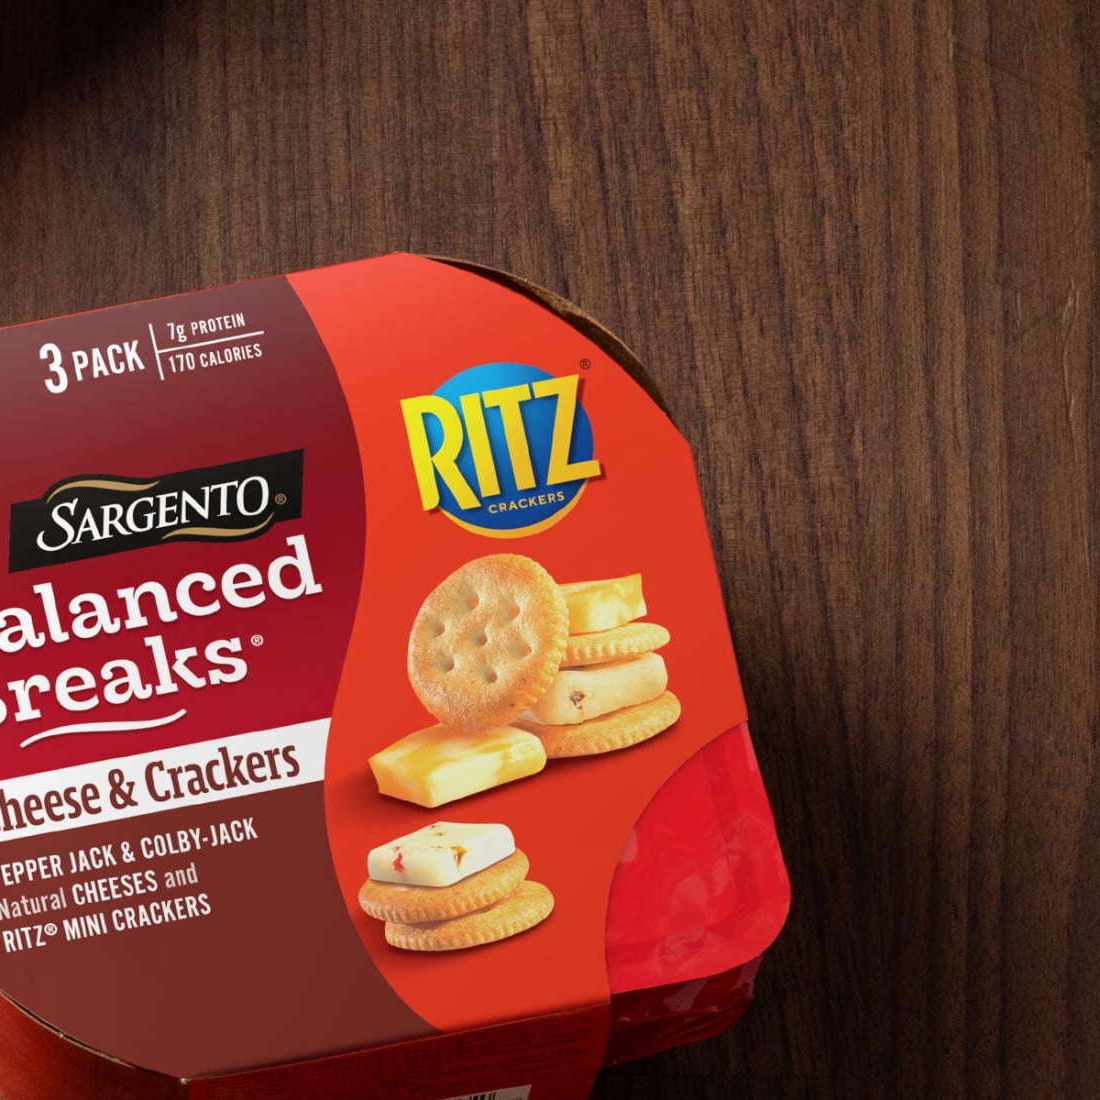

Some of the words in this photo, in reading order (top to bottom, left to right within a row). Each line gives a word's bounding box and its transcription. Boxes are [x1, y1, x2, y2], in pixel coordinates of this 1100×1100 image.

[167, 323, 187, 342] 7g
[191, 313, 245, 335] PROTEIN
[39, 343, 68, 393] 3
[72, 340, 145, 381] PACK
[169, 353, 195, 372] 170
[200, 344, 262, 367] CALORIES
[487, 491, 566, 514] CRACKERS
[108, 769, 138, 809] &
[145, 745, 300, 802] Crackers
[70, 845, 116, 873] JACK
[121, 842, 135, 862] &
[141, 818, 257, 858] COLBY-JACK
[72, 870, 157, 905] CHEESES
[165, 862, 198, 888] and
[63, 913, 107, 940] MINI
[112, 894, 210, 930] CRACKERS
